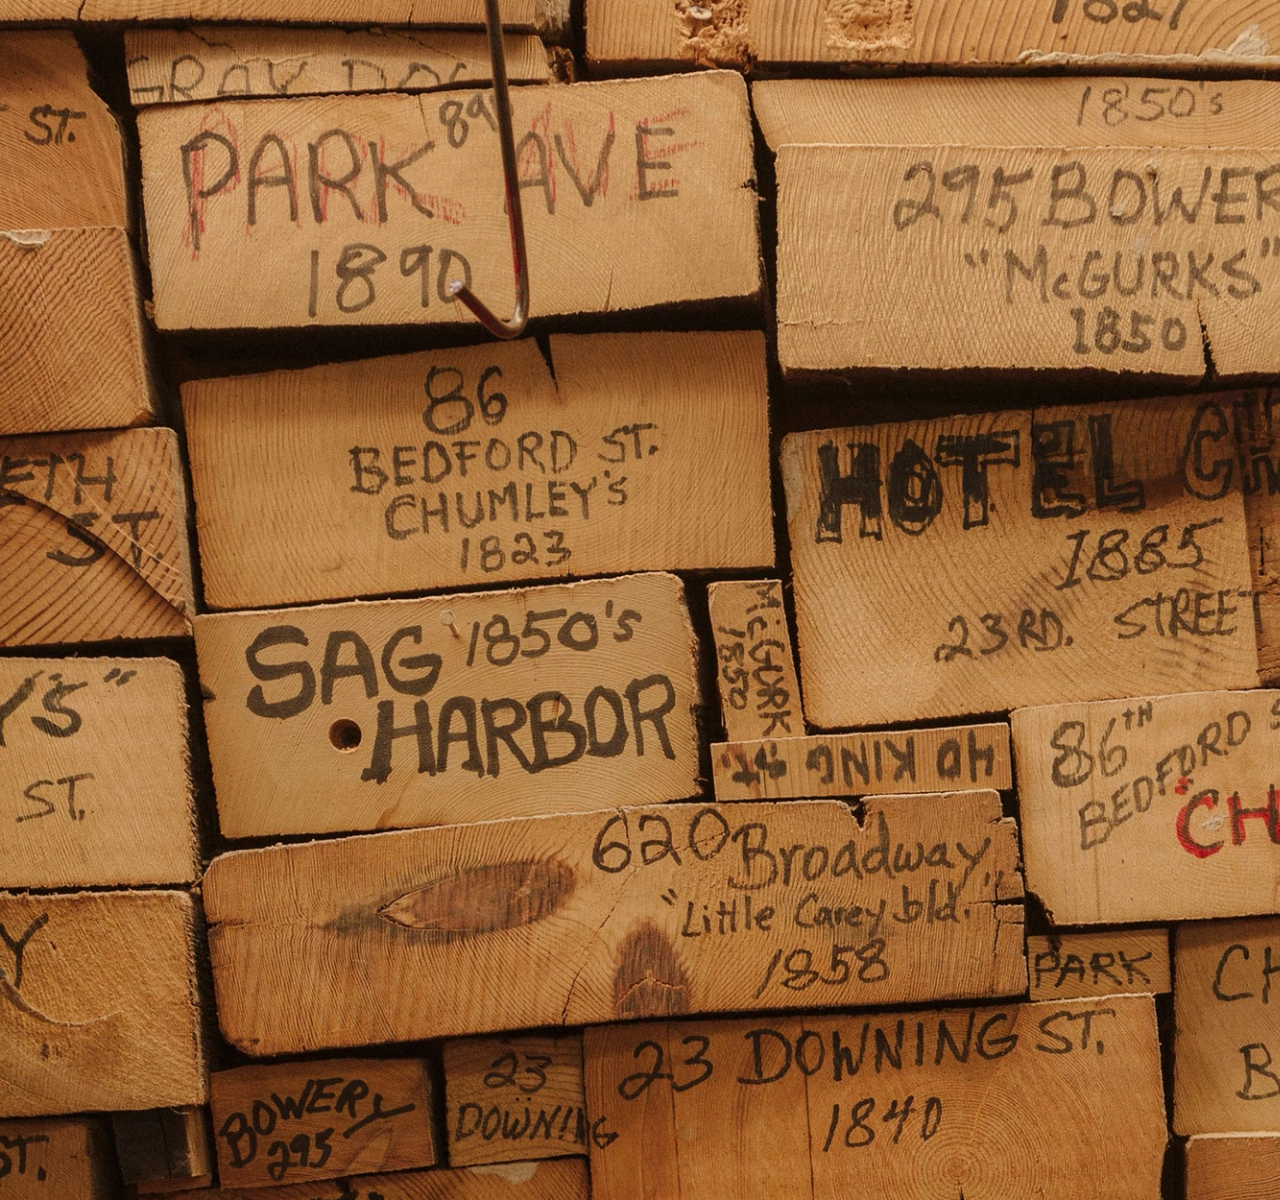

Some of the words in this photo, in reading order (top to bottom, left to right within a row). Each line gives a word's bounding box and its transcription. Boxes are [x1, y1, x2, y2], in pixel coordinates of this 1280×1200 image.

[180, 110, 442, 256] PARK
[502, 112, 706, 218] AVE
[894, 161, 1034, 233] 295
[309, 244, 471, 318] 1890
[1070, 308, 1188, 355] 1850
[424, 366, 509, 436] 86
[349, 429, 578, 496] BEDFORD
[813, 412, 1146, 544] HOTEL
[461, 530, 573, 573] 1823
[1053, 517, 1224, 591] 1885
[1112, 587, 1268, 643] STREET
[245, 625, 443, 720] SAG
[717, 625, 750, 712] 1850
[360, 673, 679, 784] HARBOR
[804, 737, 916, 786] KING
[935, 731, 996, 783] 40
[1080, 708, 1252, 853] BEDFORD
[591, 807, 729, 873] 620
[753, 940, 891, 1000] 1858
[1033, 932, 1154, 990] PARK
[483, 1049, 554, 1094] 23
[618, 1035, 713, 1100] 23
[737, 1011, 1019, 1085] DOWNING
[219, 1078, 417, 1170] BOWERY
[267, 1126, 333, 1182] 295
[456, 1102, 620, 1149] DOWNING
[822, 1097, 944, 1153] 1840
